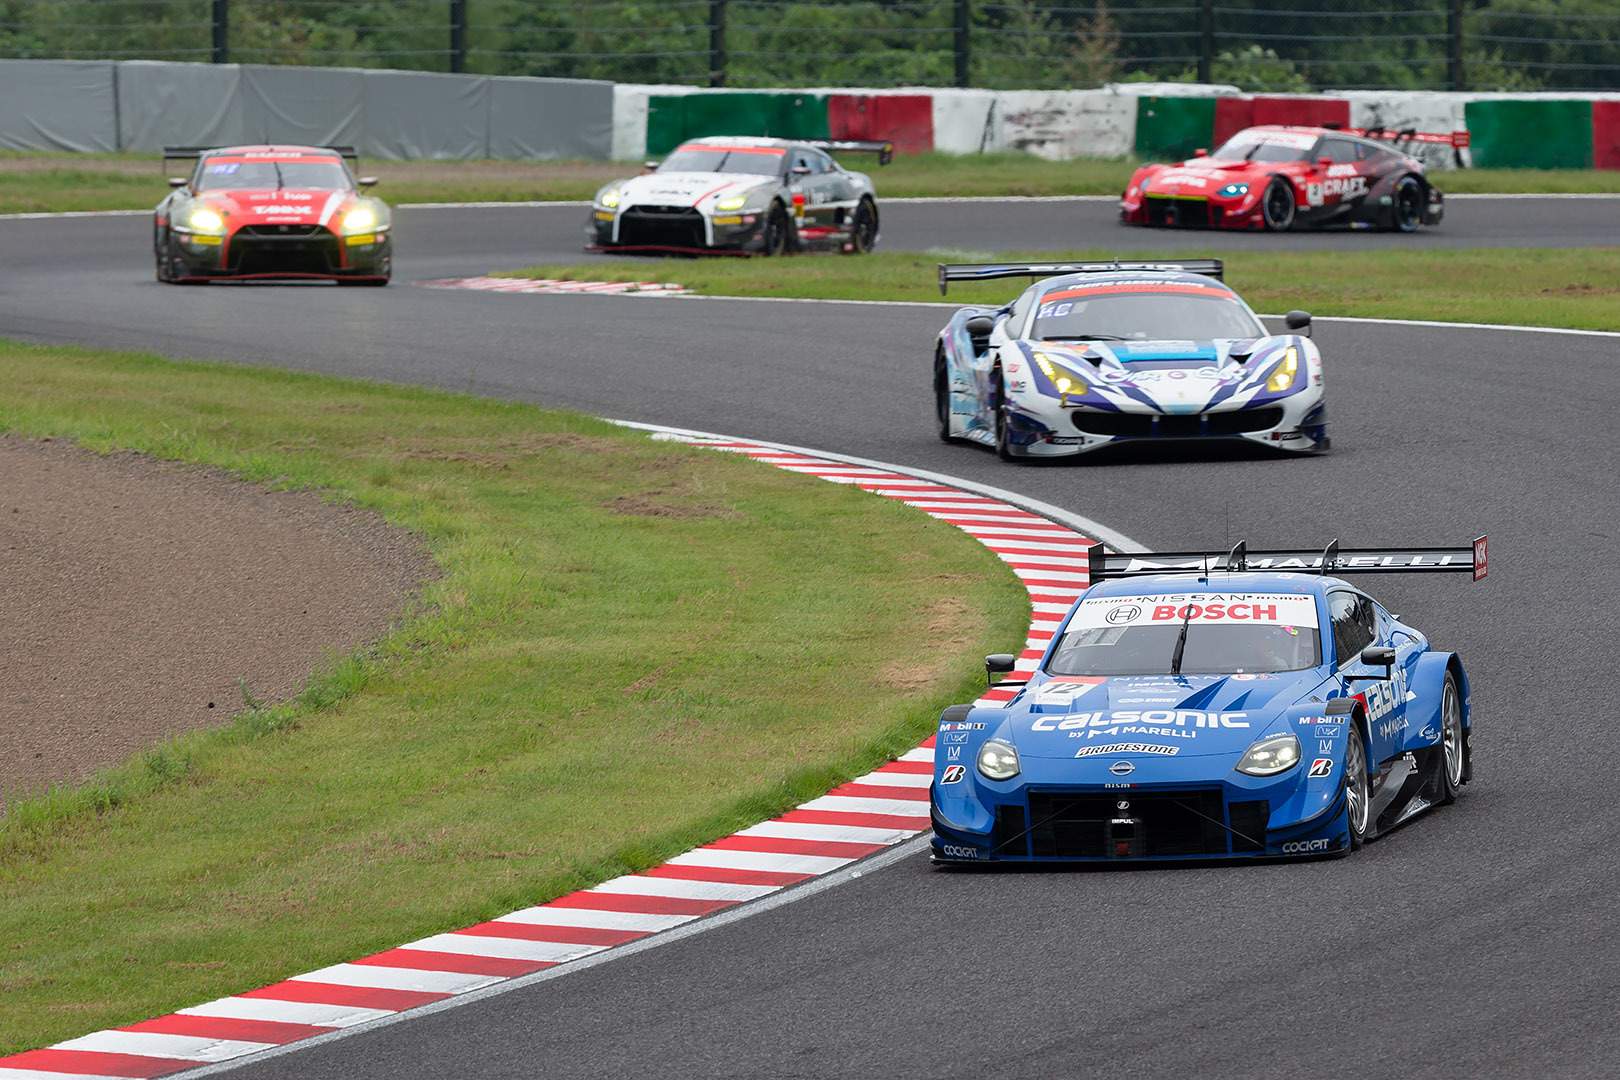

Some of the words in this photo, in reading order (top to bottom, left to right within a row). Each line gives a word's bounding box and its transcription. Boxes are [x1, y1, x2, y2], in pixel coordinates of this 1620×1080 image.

[1141, 595, 1246, 603] NISSAN
[1151, 604, 1277, 621] BOSCH
[1043, 682, 1084, 694] 12
[1299, 716, 1332, 725] Mobil
[940, 722, 973, 732] Mobil
[1122, 726, 1196, 738] MARELLI
[1075, 743, 1179, 758] BRIDGESTONE
[943, 844, 978, 858] COCKPIT
[1282, 838, 1330, 853] COCKPIT
